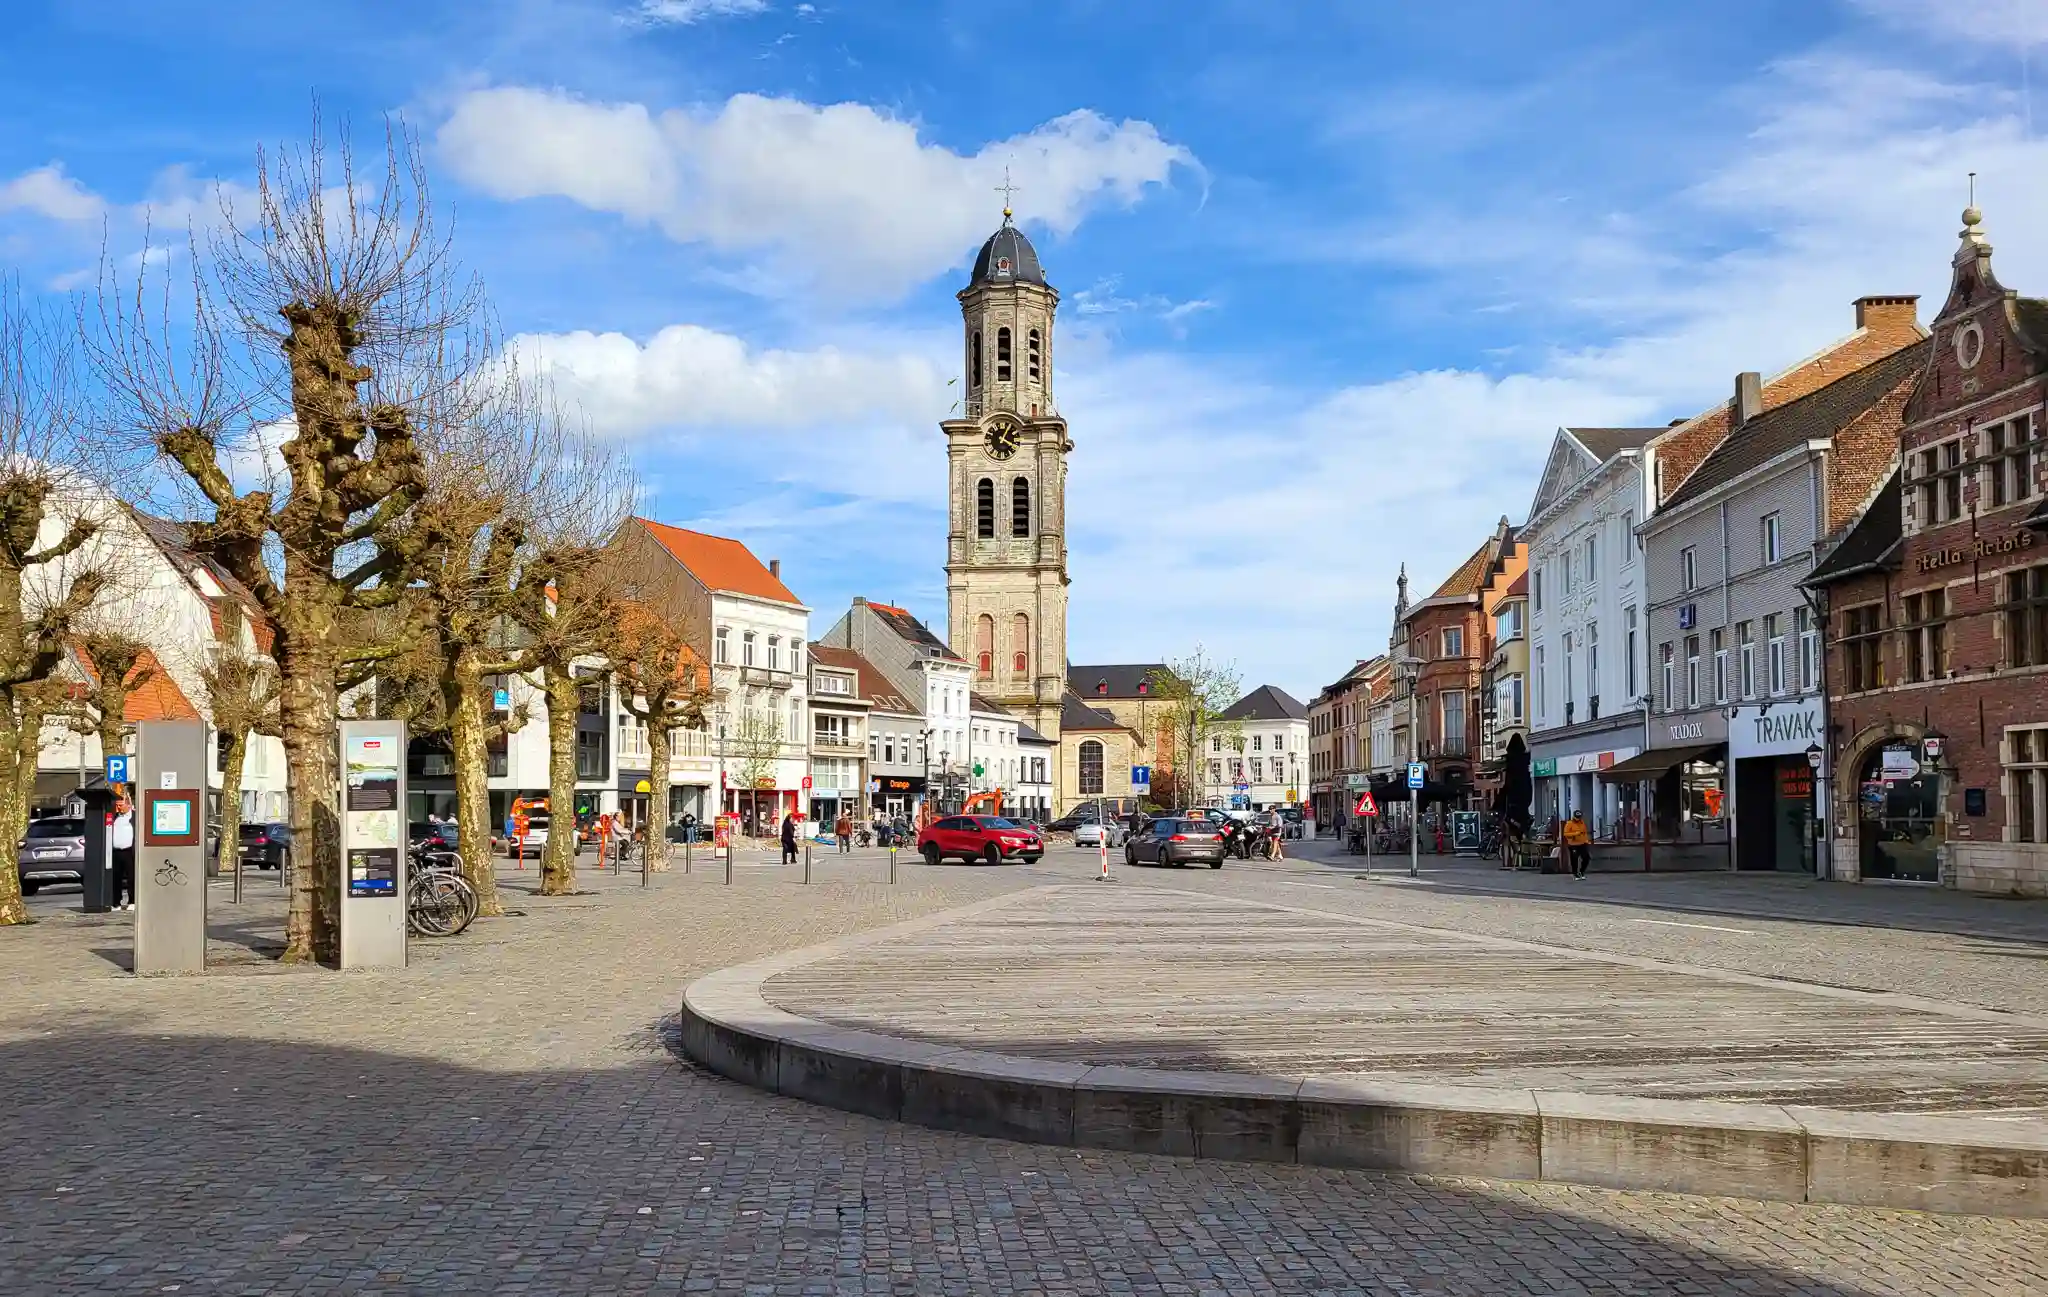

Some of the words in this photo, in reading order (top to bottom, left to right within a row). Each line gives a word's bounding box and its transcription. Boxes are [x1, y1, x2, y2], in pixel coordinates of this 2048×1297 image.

[1972, 530, 2032, 557] Artois
[1669, 722, 1704, 741] MADOX
[1753, 710, 1816, 744] TRAVAK
[110, 760, 123, 778] P
[1412, 766, 1420, 778] P
[890, 779, 910, 790] Orange
[1458, 822, 1466, 834] 3
